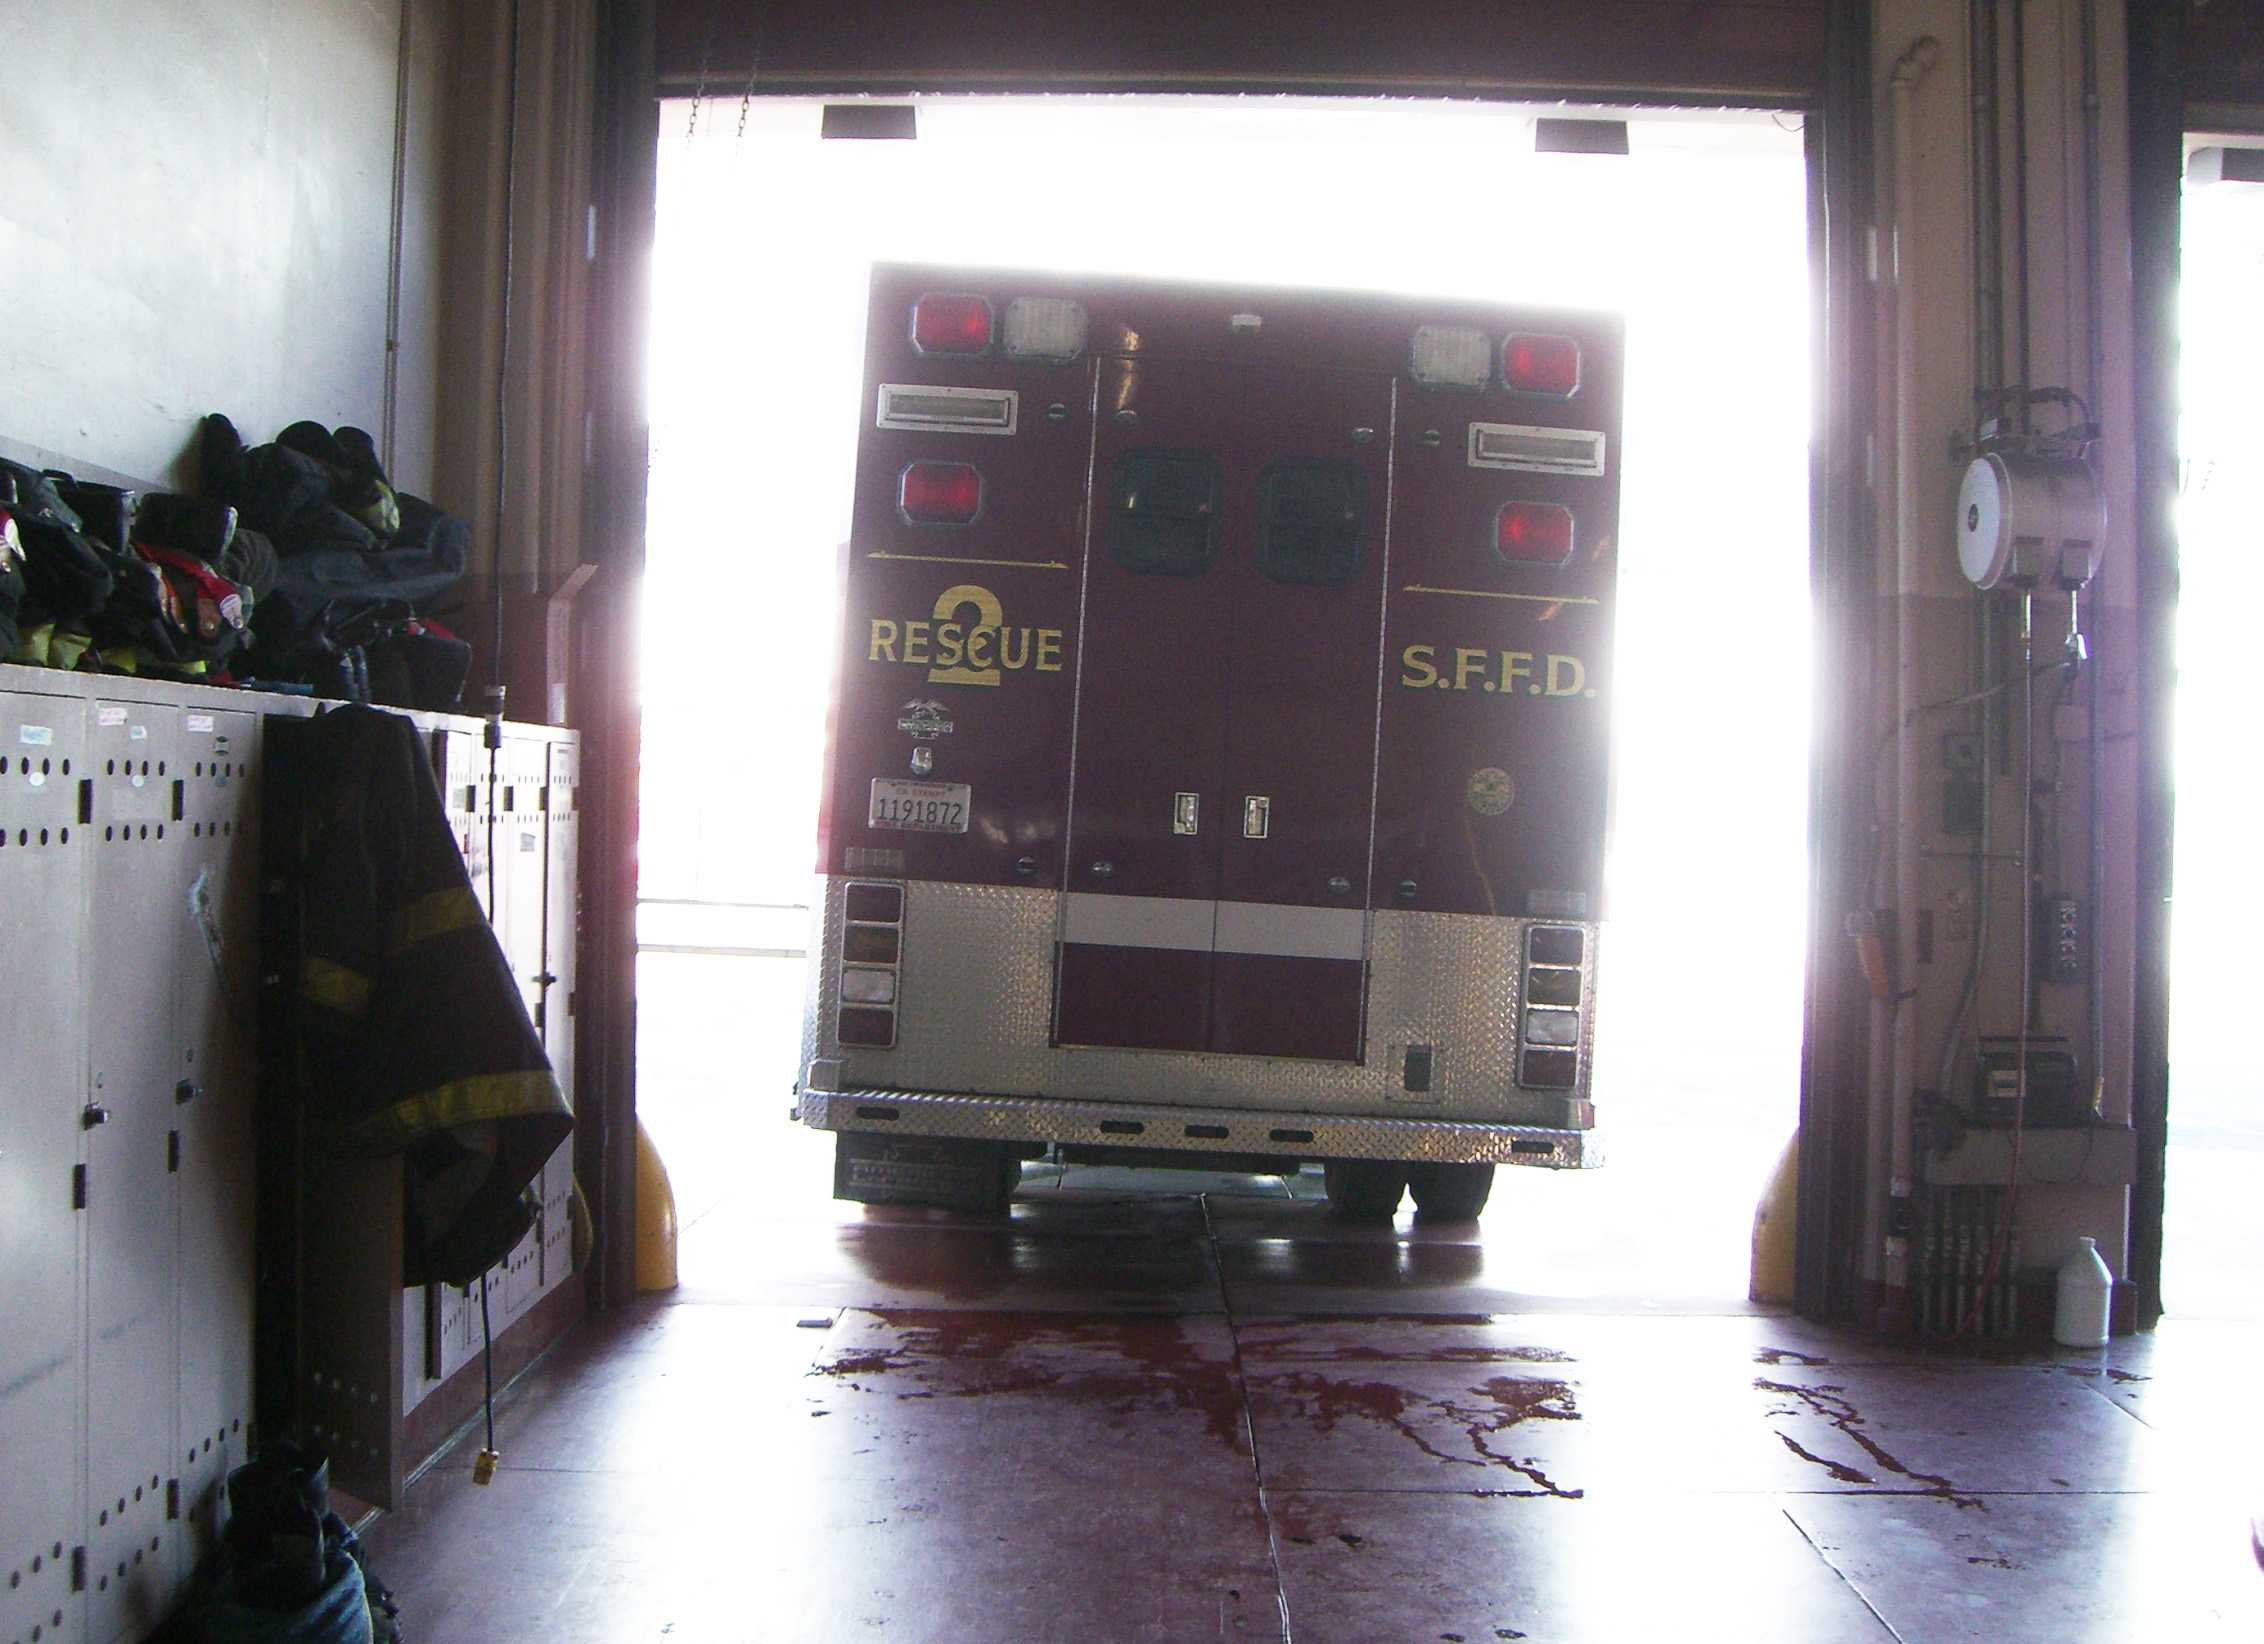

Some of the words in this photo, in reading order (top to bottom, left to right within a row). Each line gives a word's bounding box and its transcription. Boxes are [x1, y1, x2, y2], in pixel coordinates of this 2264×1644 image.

[868, 619, 1064, 672] RESCUE
[927, 584, 1004, 687] 2
[1401, 645, 1598, 699] S.F.F.D.
[877, 798, 963, 825] 1191872
